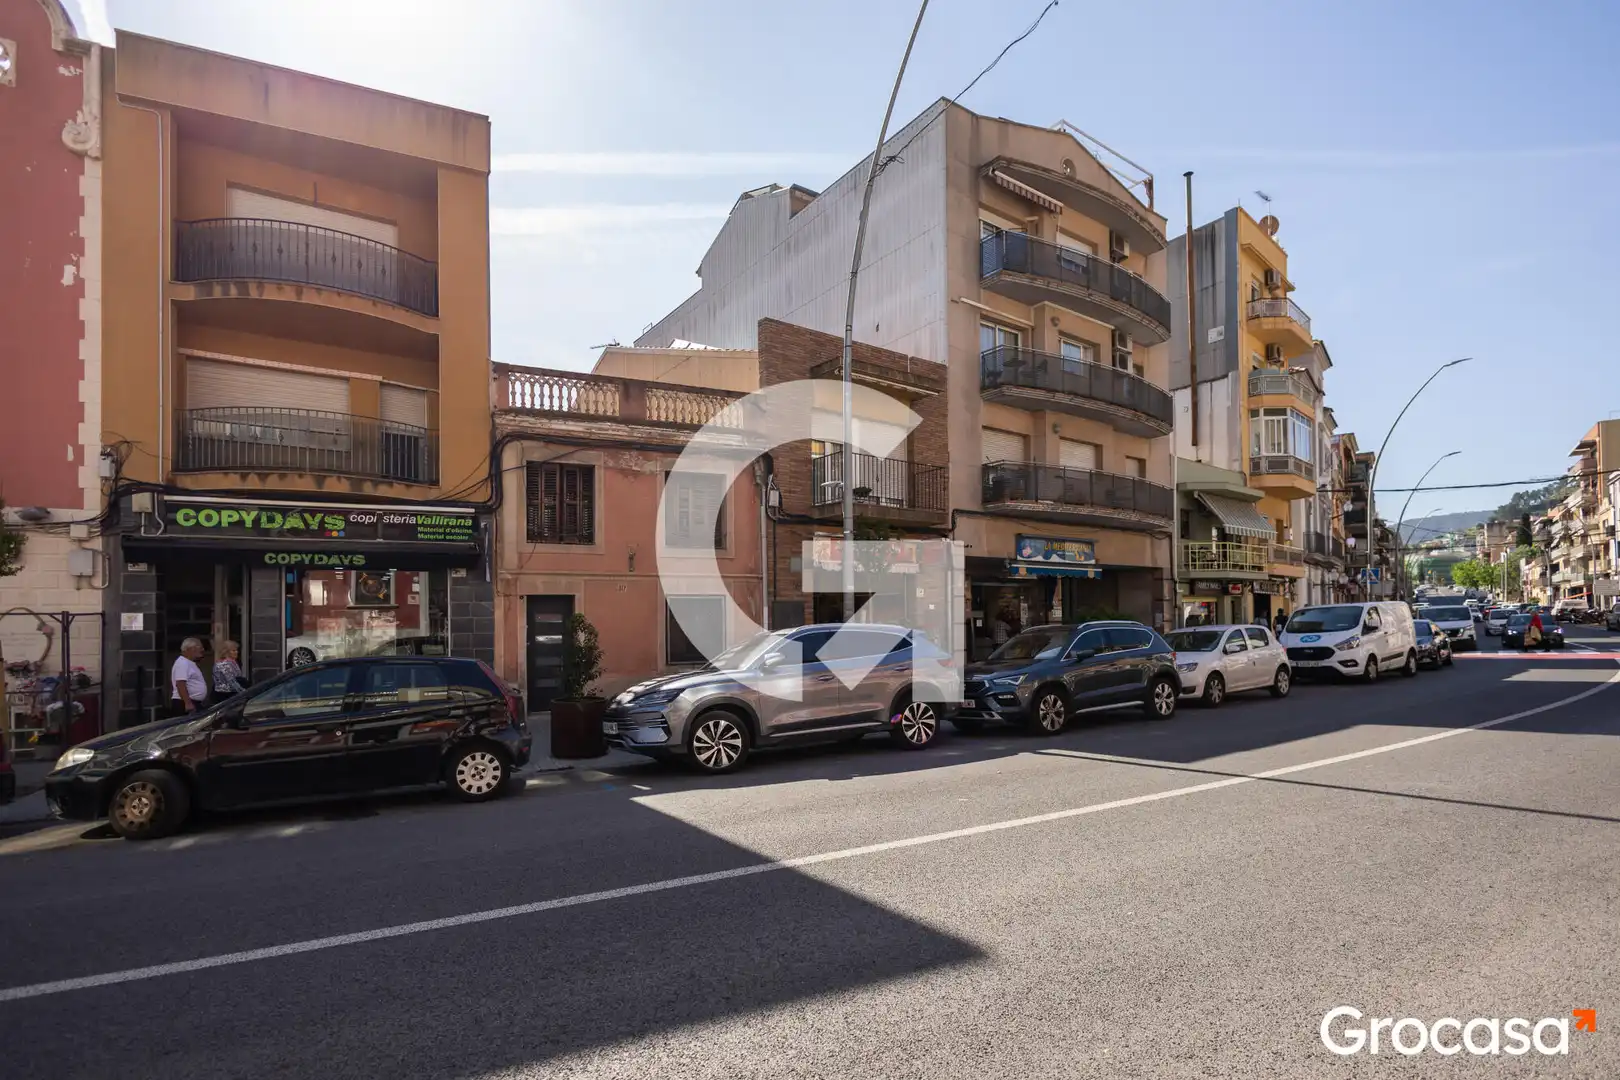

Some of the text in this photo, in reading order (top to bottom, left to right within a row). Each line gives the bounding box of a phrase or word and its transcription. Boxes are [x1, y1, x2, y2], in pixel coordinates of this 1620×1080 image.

[176, 508, 345, 530] COPYDAYS
[416, 515, 473, 527] Vallirana
[264, 553, 366, 566] COPYDAYS
